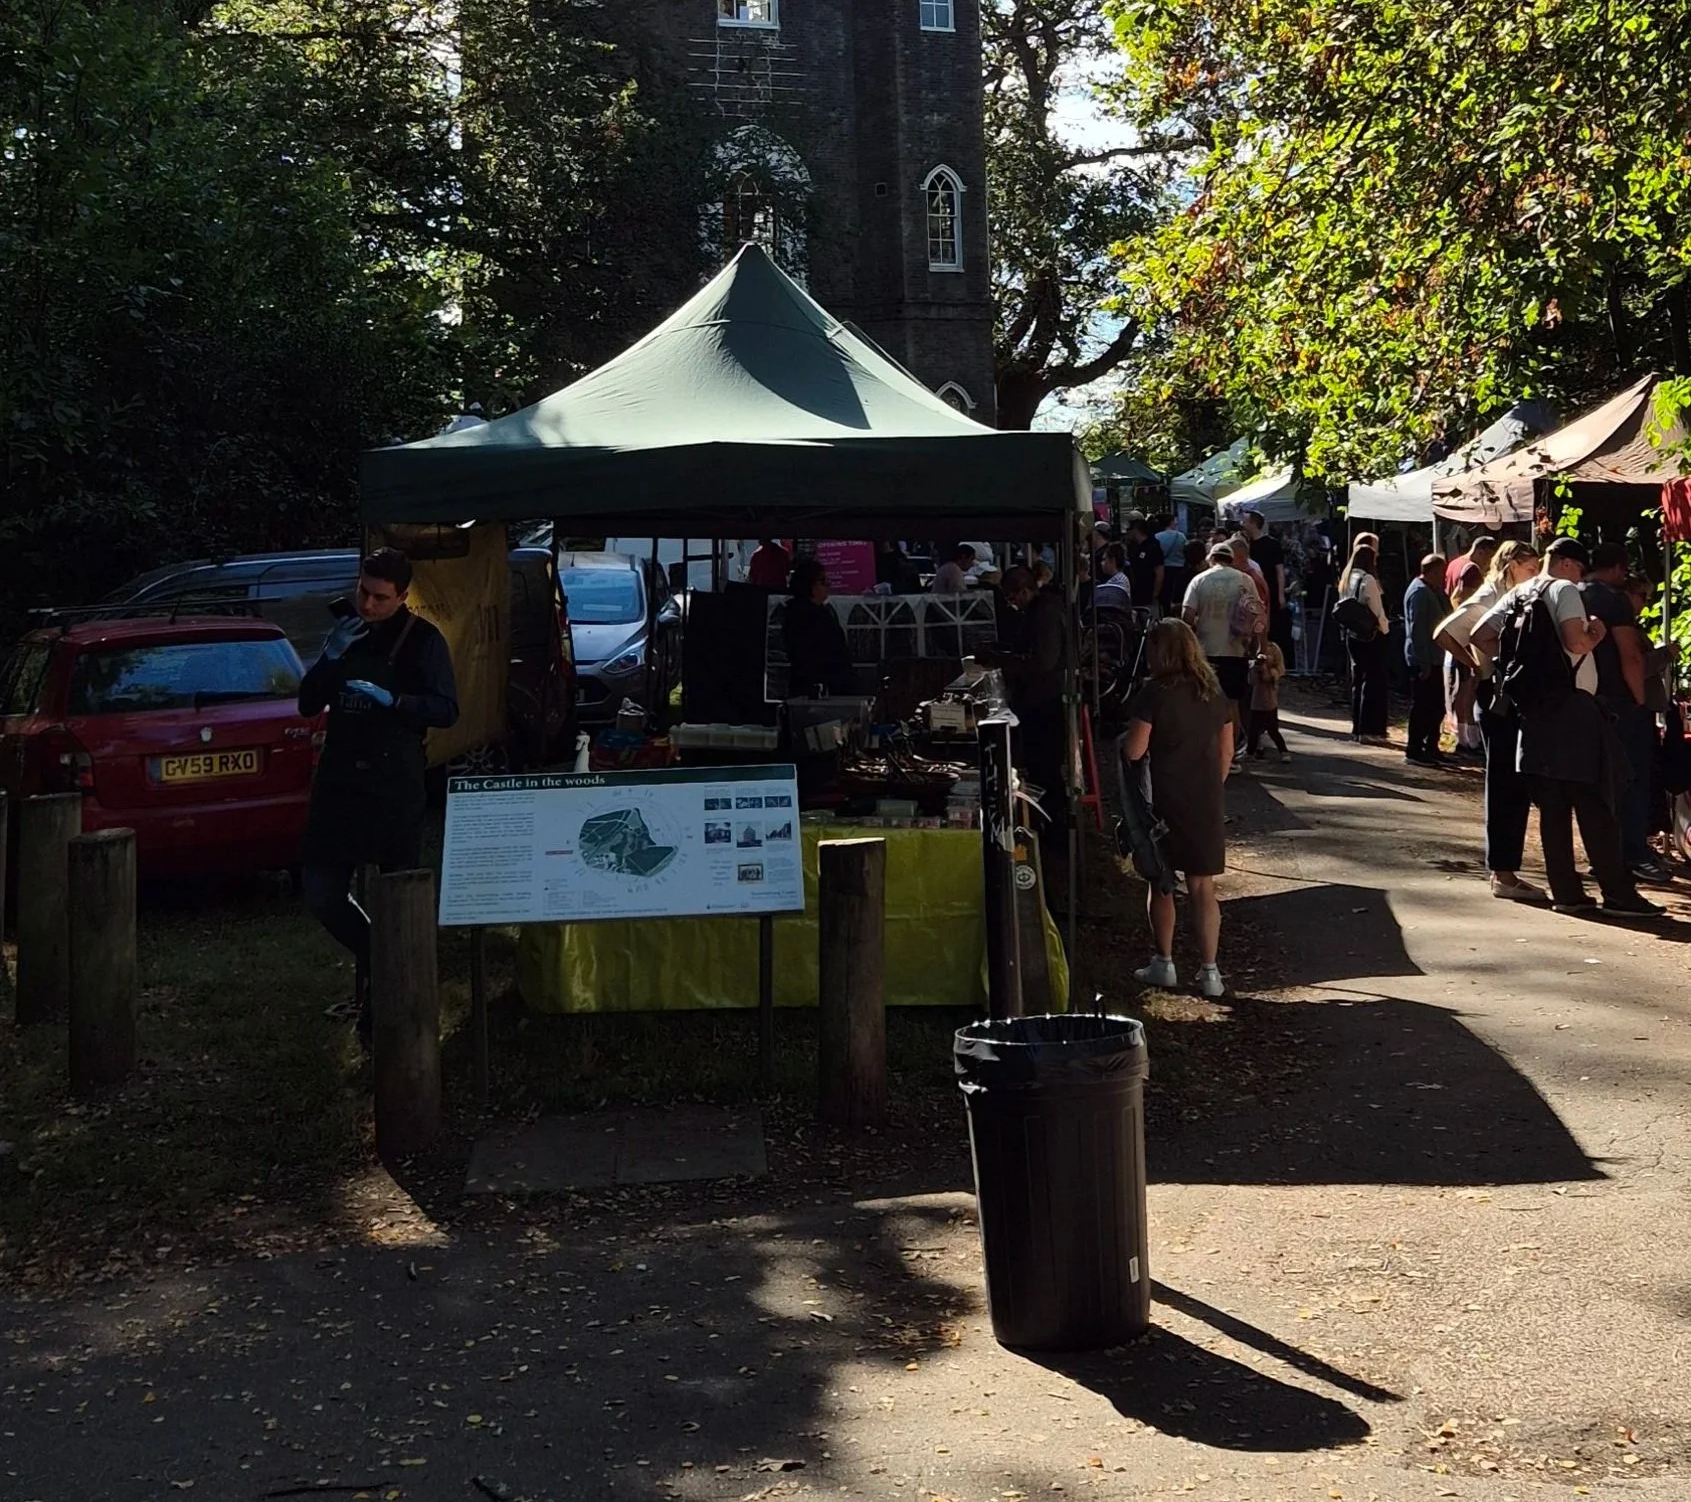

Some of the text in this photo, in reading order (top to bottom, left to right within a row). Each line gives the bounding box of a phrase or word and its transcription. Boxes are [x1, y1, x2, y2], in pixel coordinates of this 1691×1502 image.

[165, 752, 254, 777] GV59 RXO
[455, 775, 606, 790] The Castle in the woods
